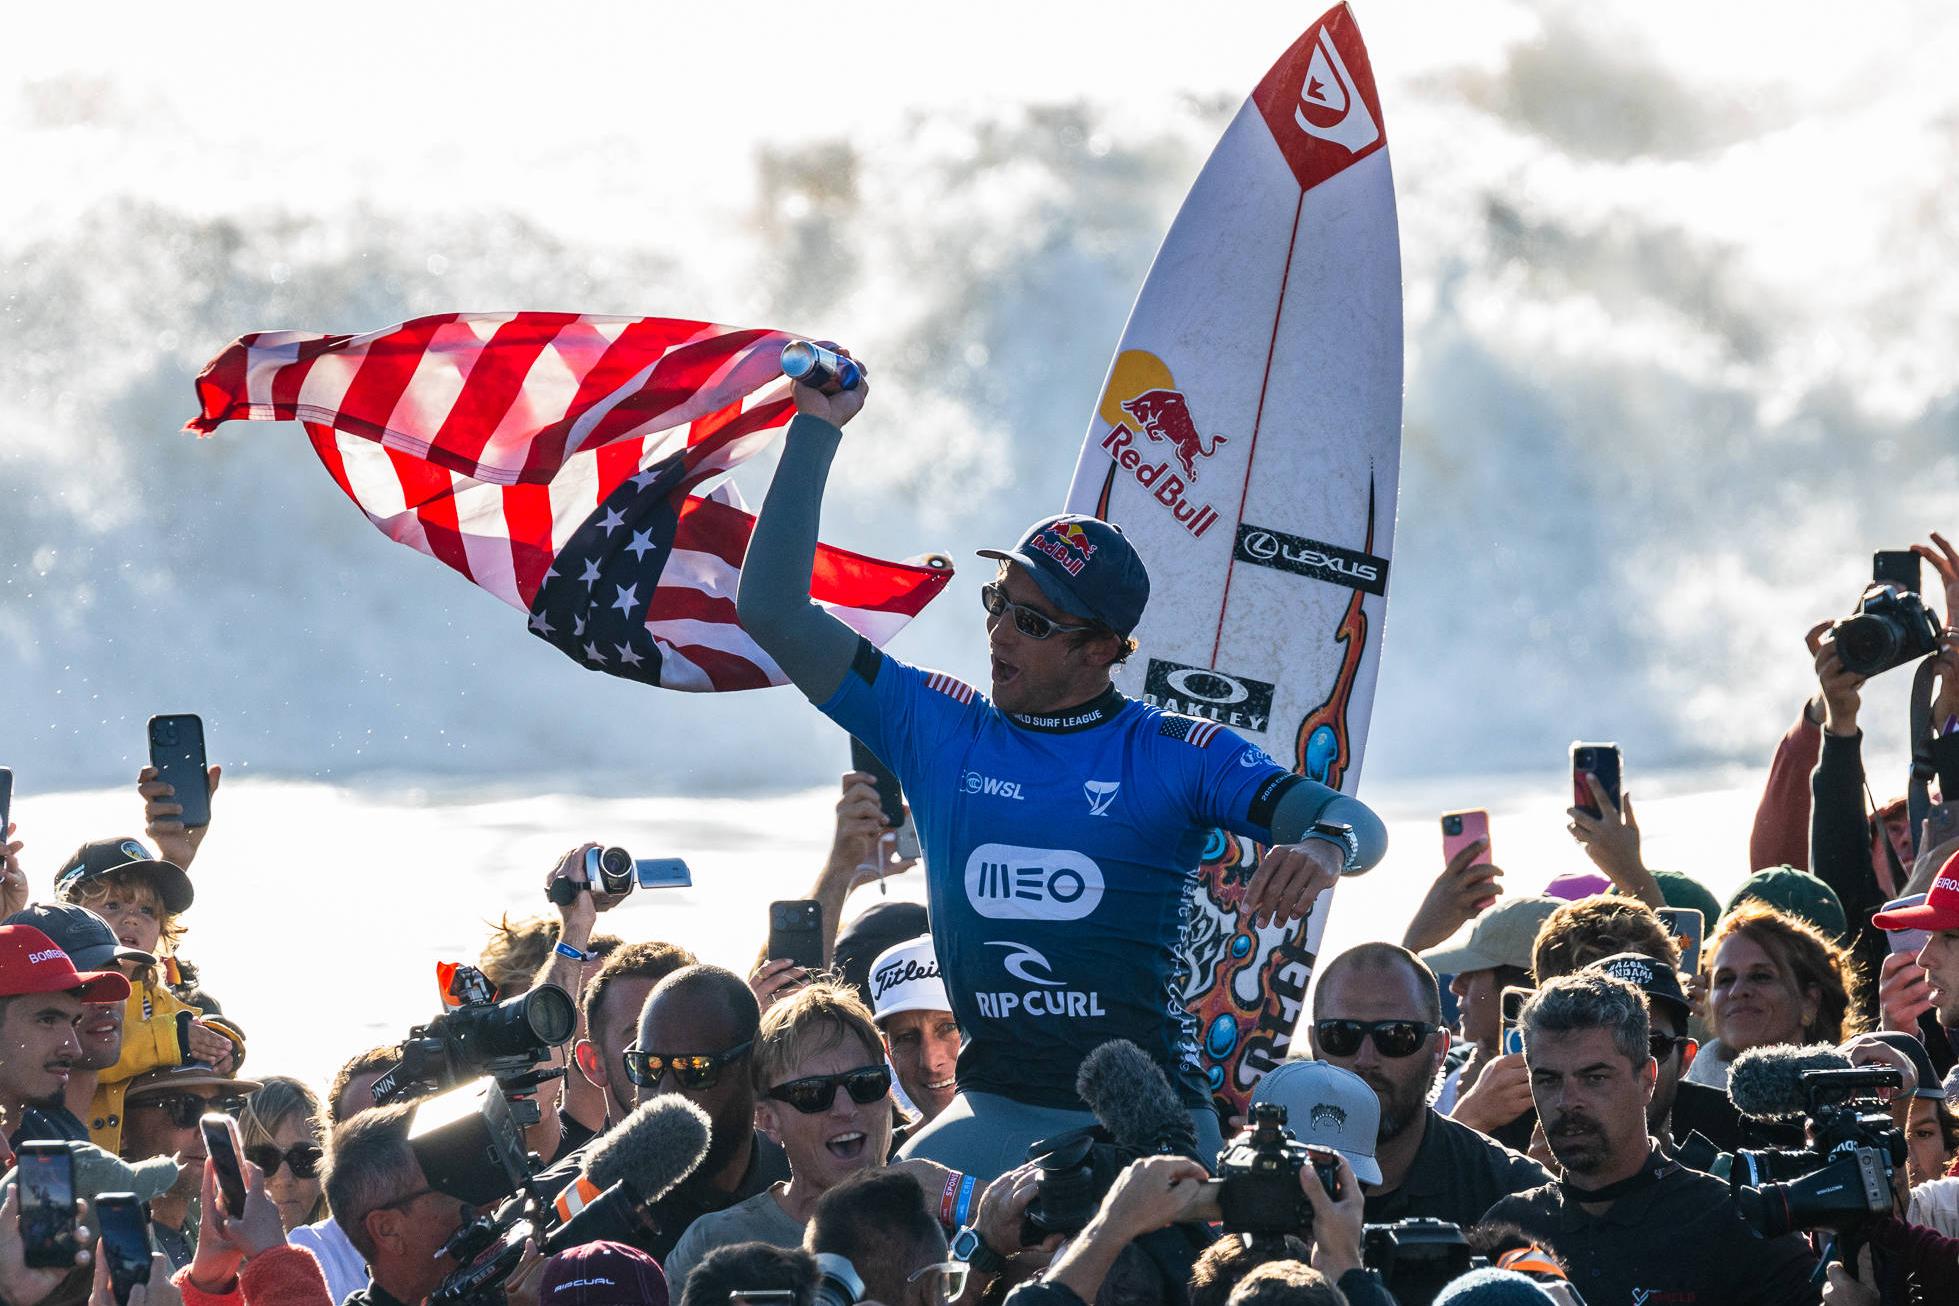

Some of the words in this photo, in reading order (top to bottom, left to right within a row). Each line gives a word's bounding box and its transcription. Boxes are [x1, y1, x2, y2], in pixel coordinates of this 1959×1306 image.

[1100, 422, 1170, 489] Red
[1153, 473, 1220, 539] Bull
[1030, 534, 1061, 556] Red
[1052, 544, 1085, 577] Bull
[1282, 544, 1378, 581] LEXUS
[1033, 716, 1061, 728] SURF
[1063, 709, 1103, 727] LEAGUE
[983, 776, 1025, 801] WSL
[978, 861, 1086, 904] MEO
[975, 991, 1020, 1019] RIP
[1022, 990, 1106, 1018] CURL
